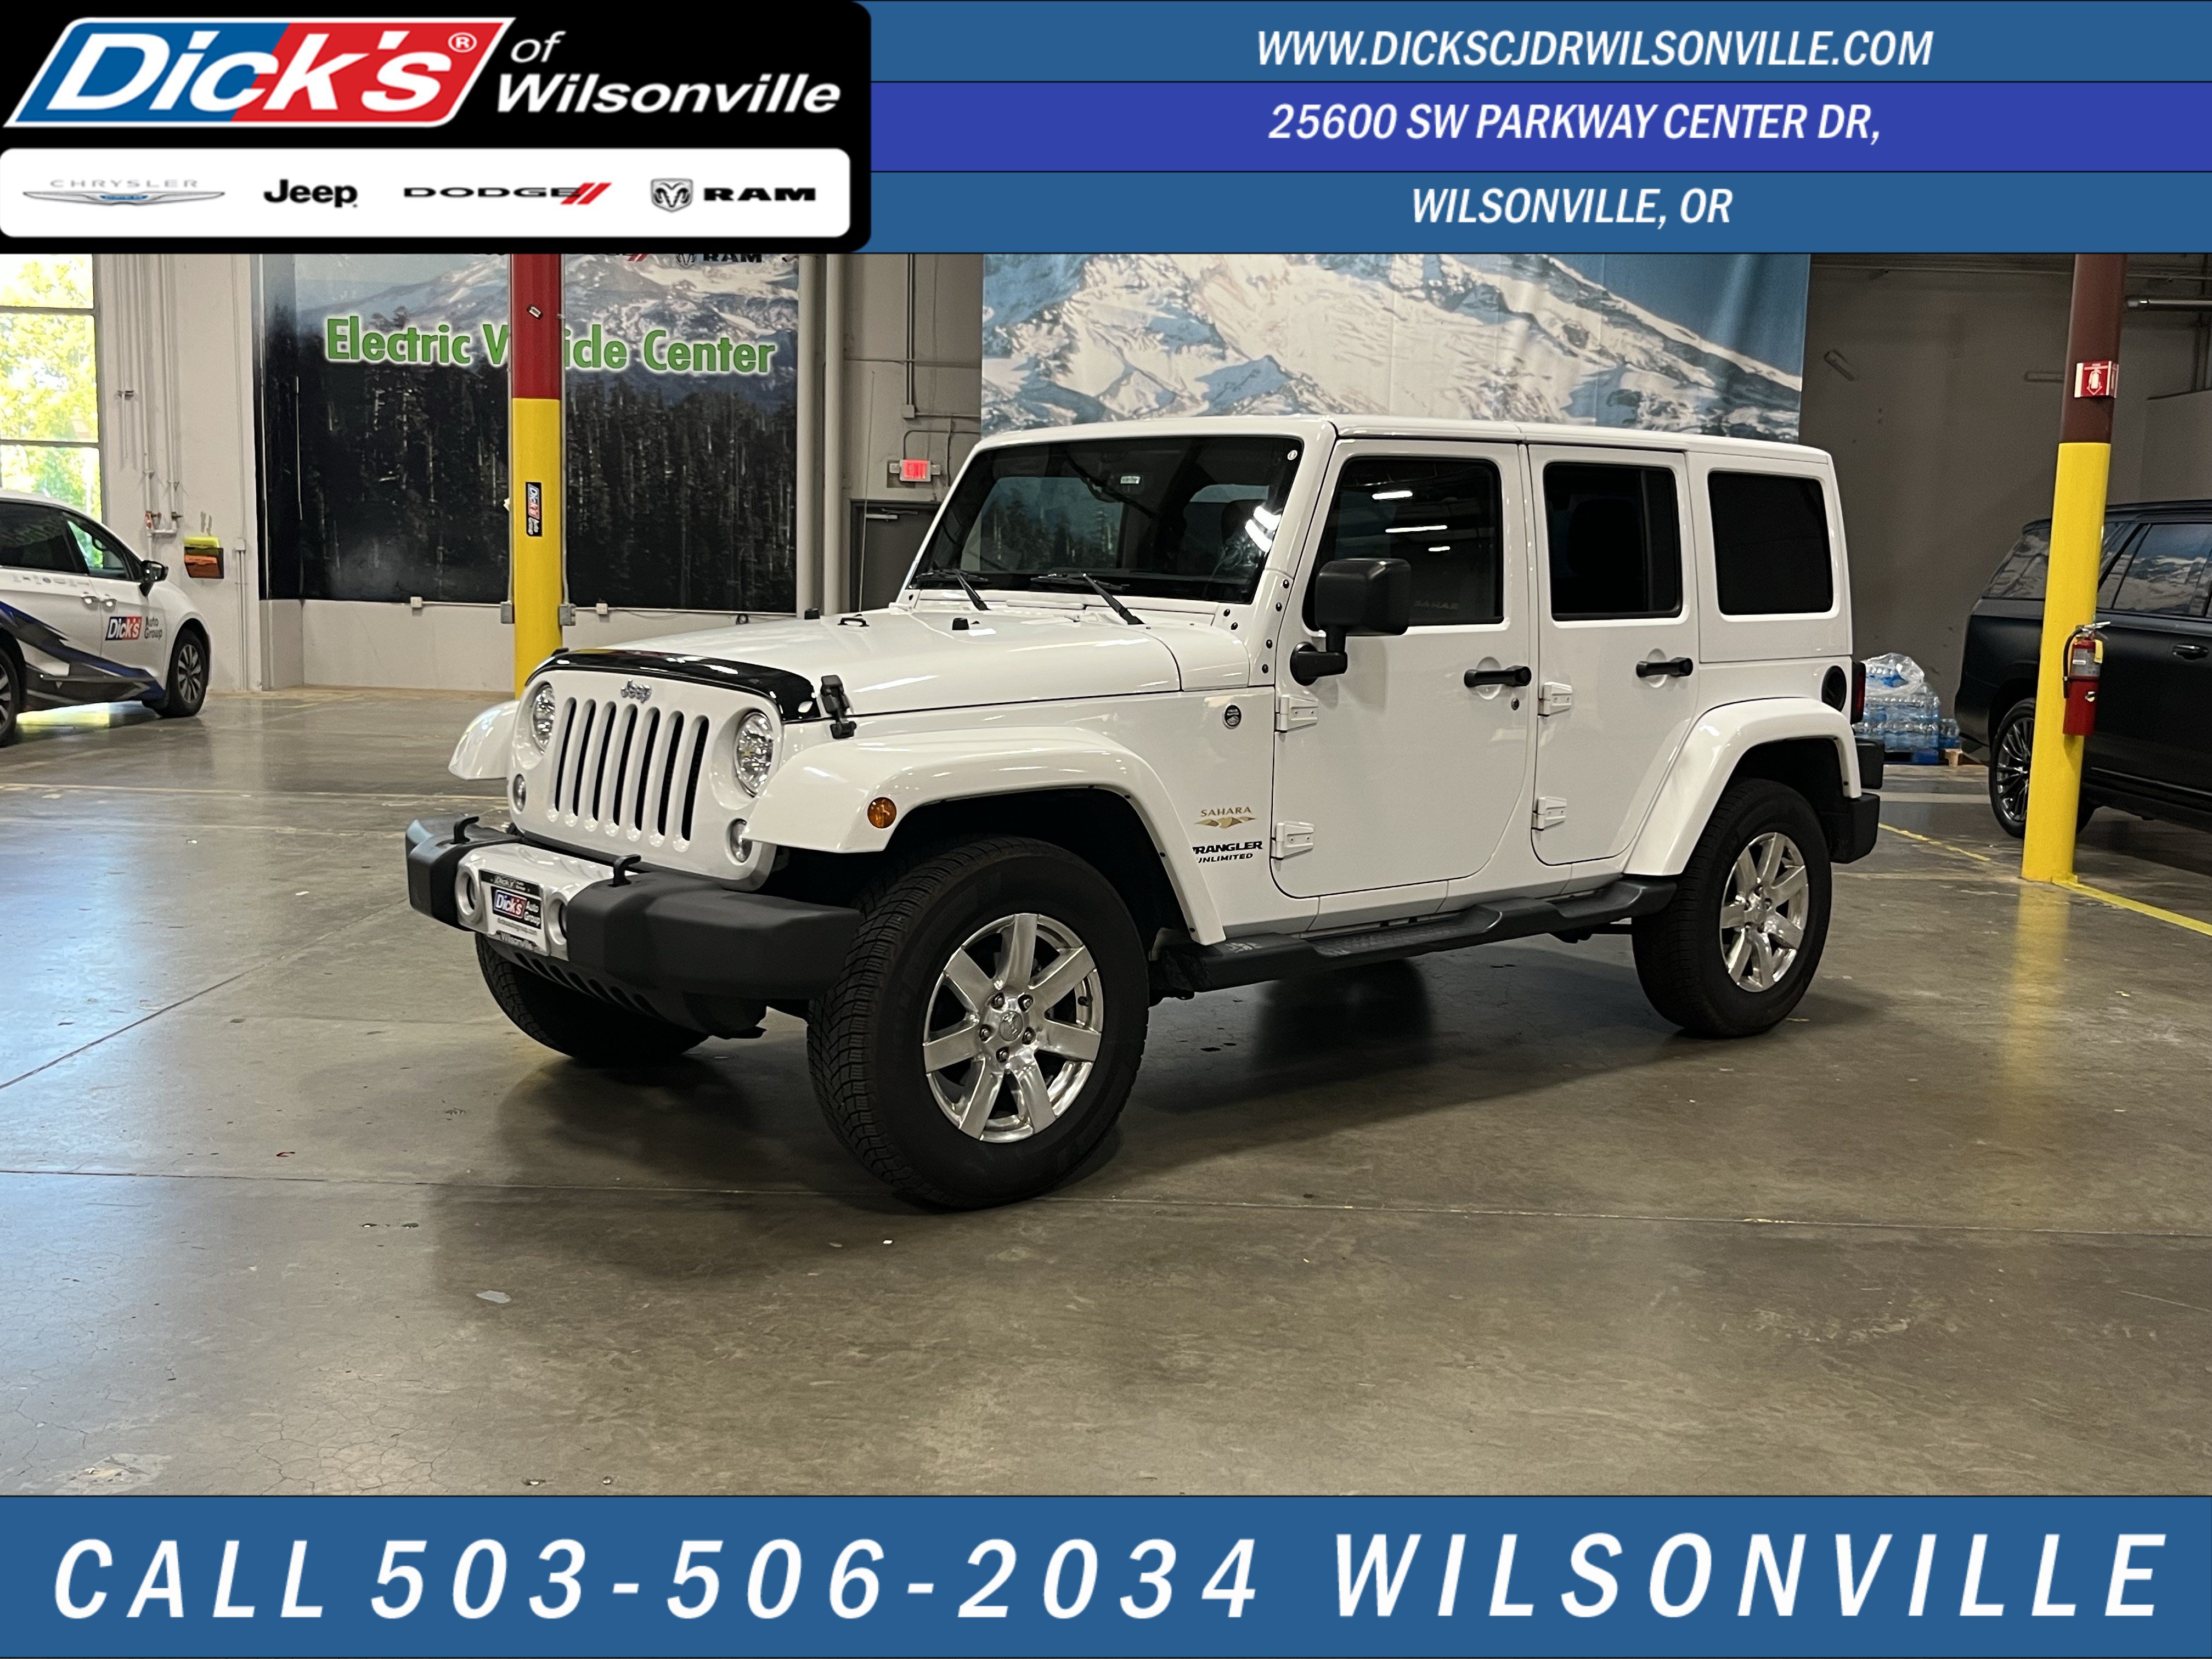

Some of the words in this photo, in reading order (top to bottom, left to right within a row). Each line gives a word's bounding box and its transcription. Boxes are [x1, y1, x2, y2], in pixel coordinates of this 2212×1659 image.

[328, 316, 471, 364] Electric
[482, 324, 627, 369] Vicle
[644, 329, 776, 373] Center
[108, 617, 141, 639] Dick's
[620, 679, 652, 704] Jeep
[1200, 806, 1252, 817] SAHARA
